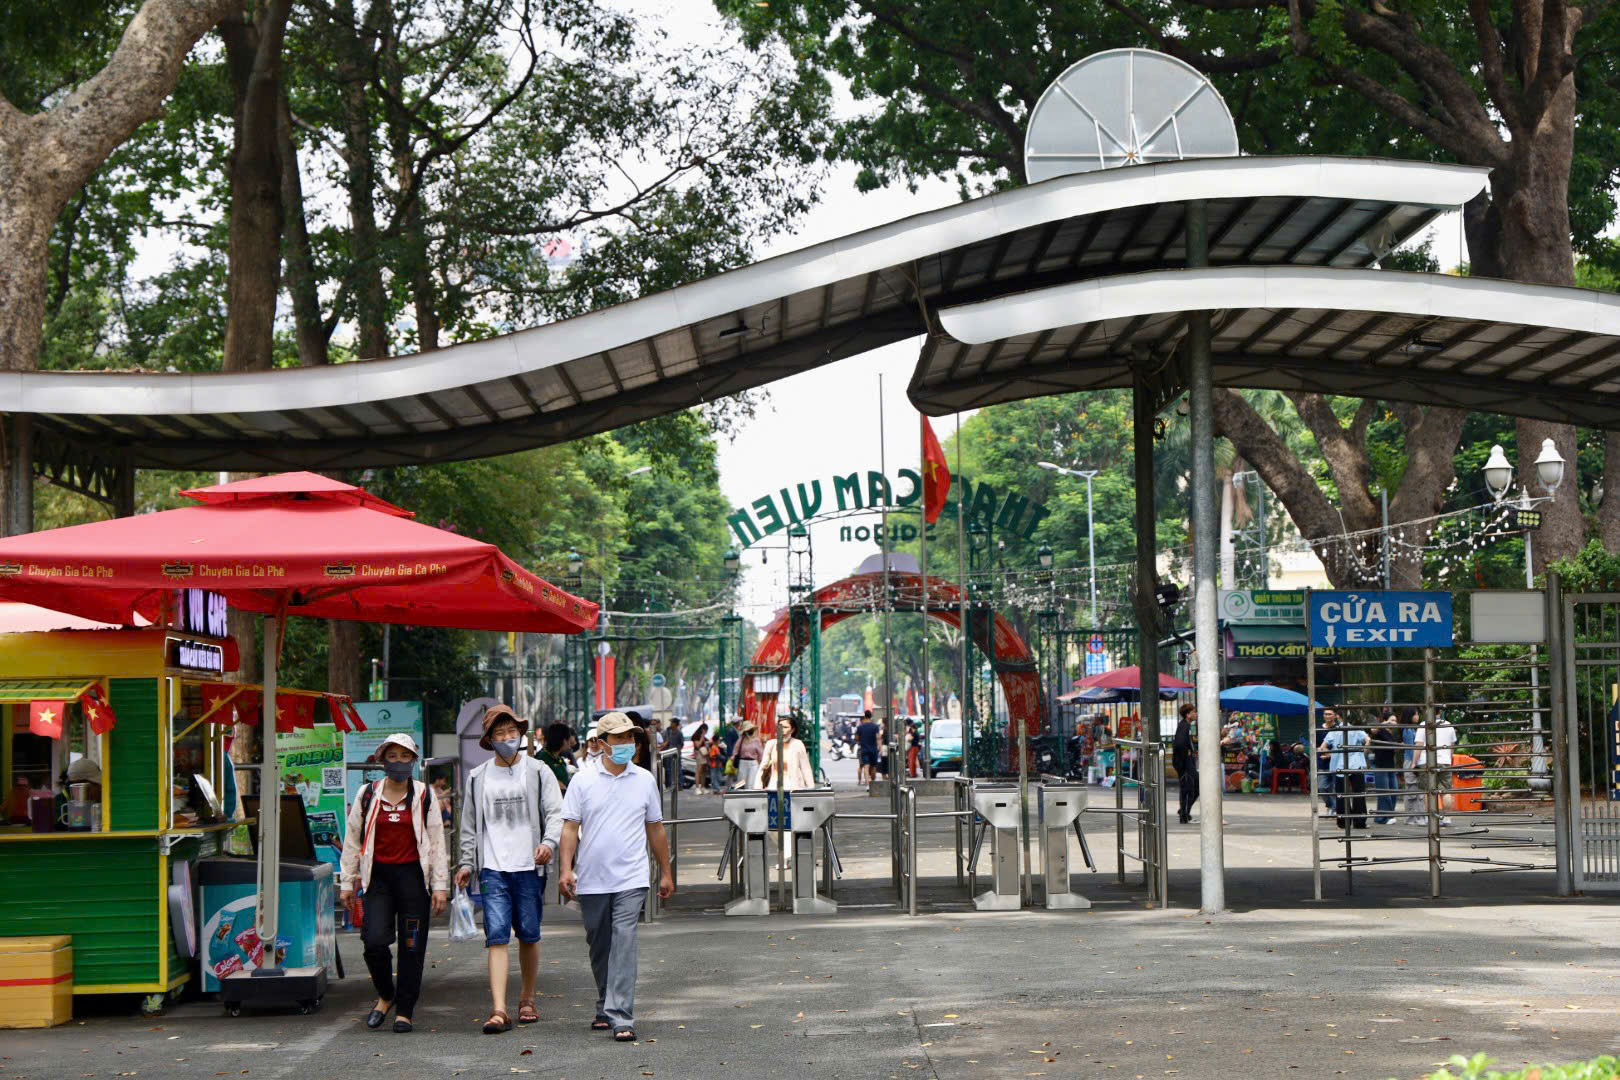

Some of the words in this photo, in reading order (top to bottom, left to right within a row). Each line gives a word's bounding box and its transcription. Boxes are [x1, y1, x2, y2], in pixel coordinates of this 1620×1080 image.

[65, 565, 80, 577] Gia
[235, 565, 250, 576] Gia
[397, 564, 412, 576] Gia
[1320, 594, 1387, 623] CỬA
[1398, 602, 1442, 623] RA
[1346, 628, 1418, 642] EXIT
[285, 748, 344, 768] PINBUS
